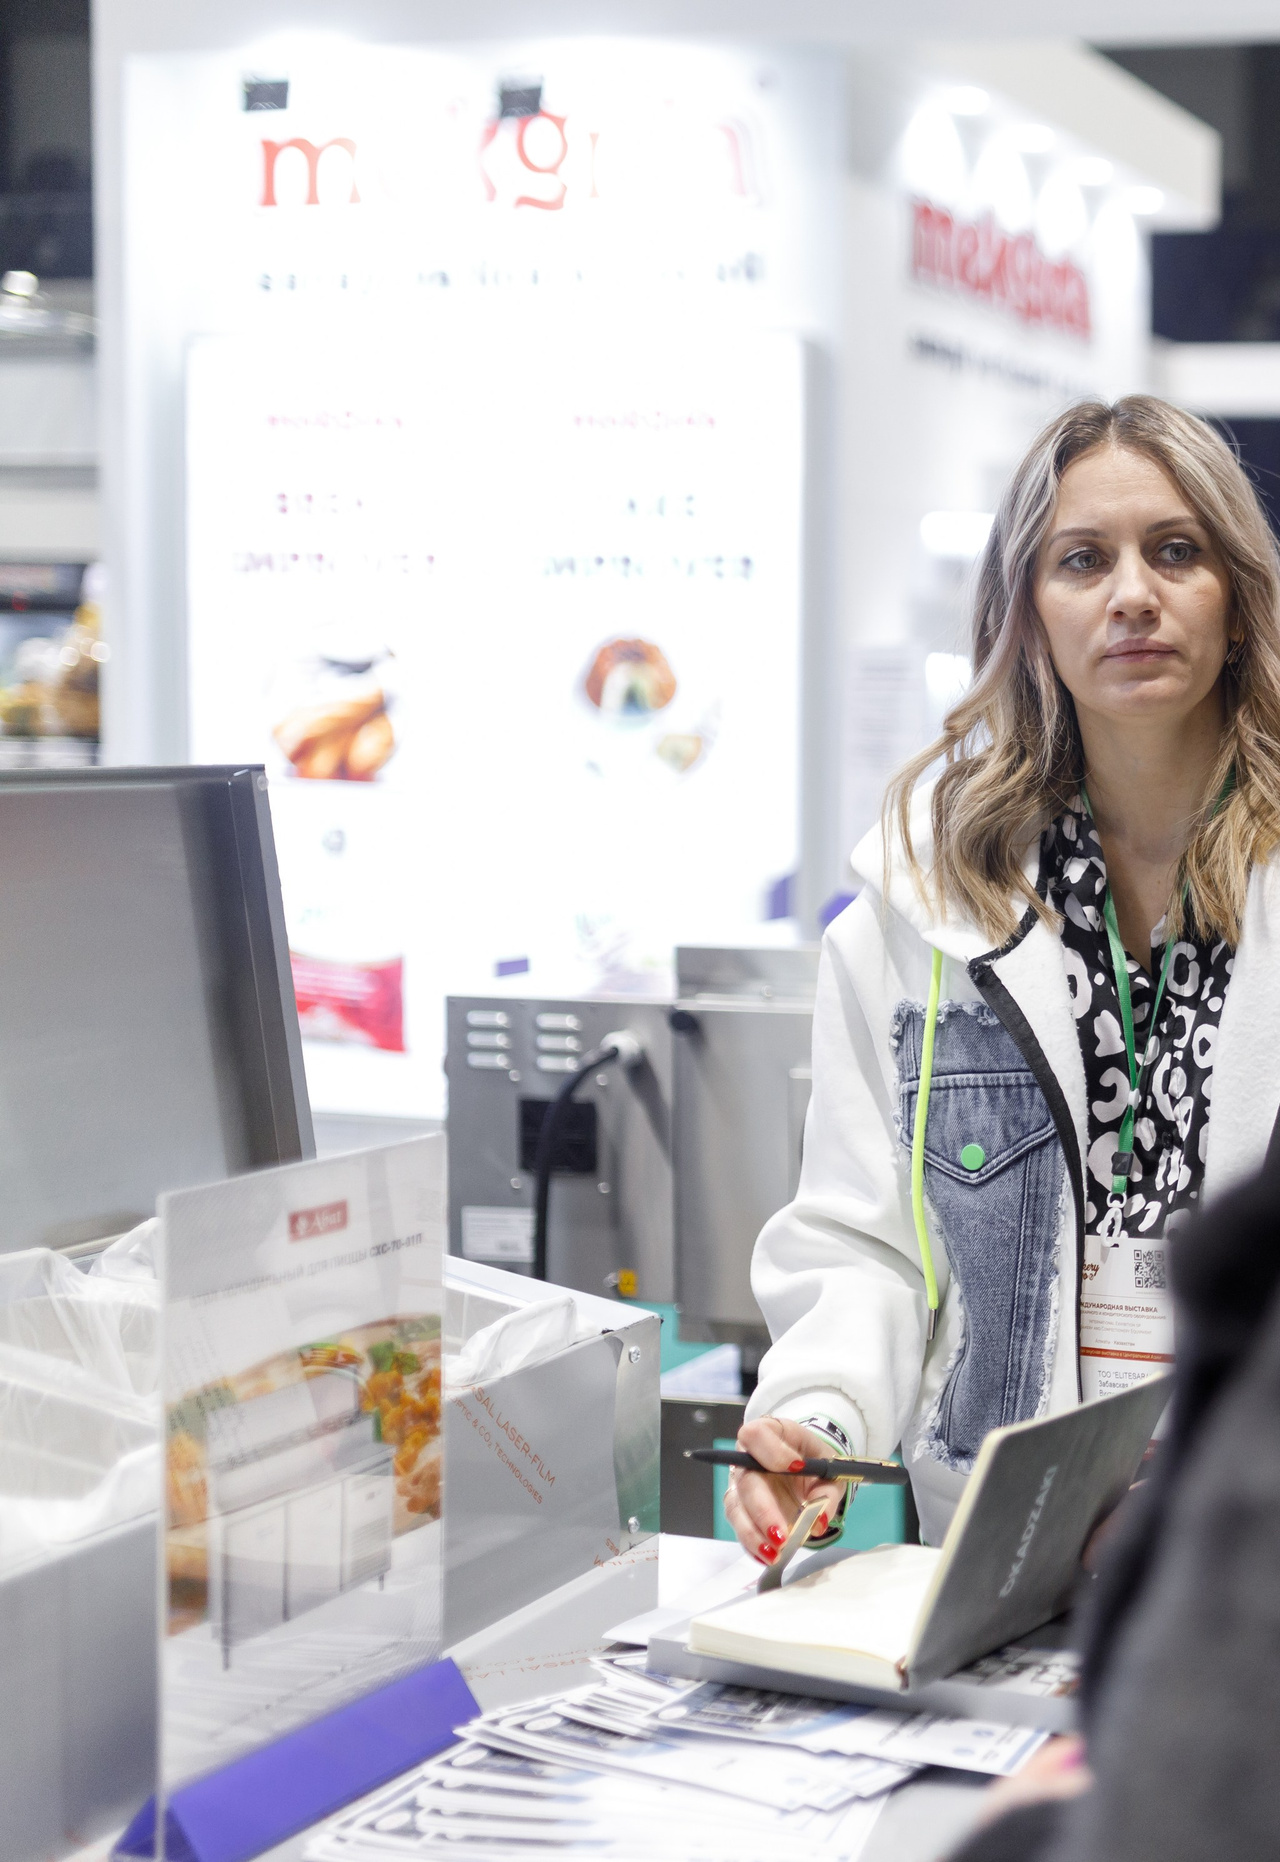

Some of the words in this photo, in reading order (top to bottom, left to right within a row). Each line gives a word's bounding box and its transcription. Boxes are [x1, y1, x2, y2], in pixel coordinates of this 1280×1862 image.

[1124, 1305, 1158, 1313] ВЫСТАВКА
[1097, 1370, 1112, 1378] ТОО
[1098, 1380, 1128, 1388] Забавская
[494, 1407, 557, 1488] LASER-FILM
[494, 1441, 544, 1505] TECHNOLOGIES
[998, 1465, 1059, 1598] OKADZAKI
